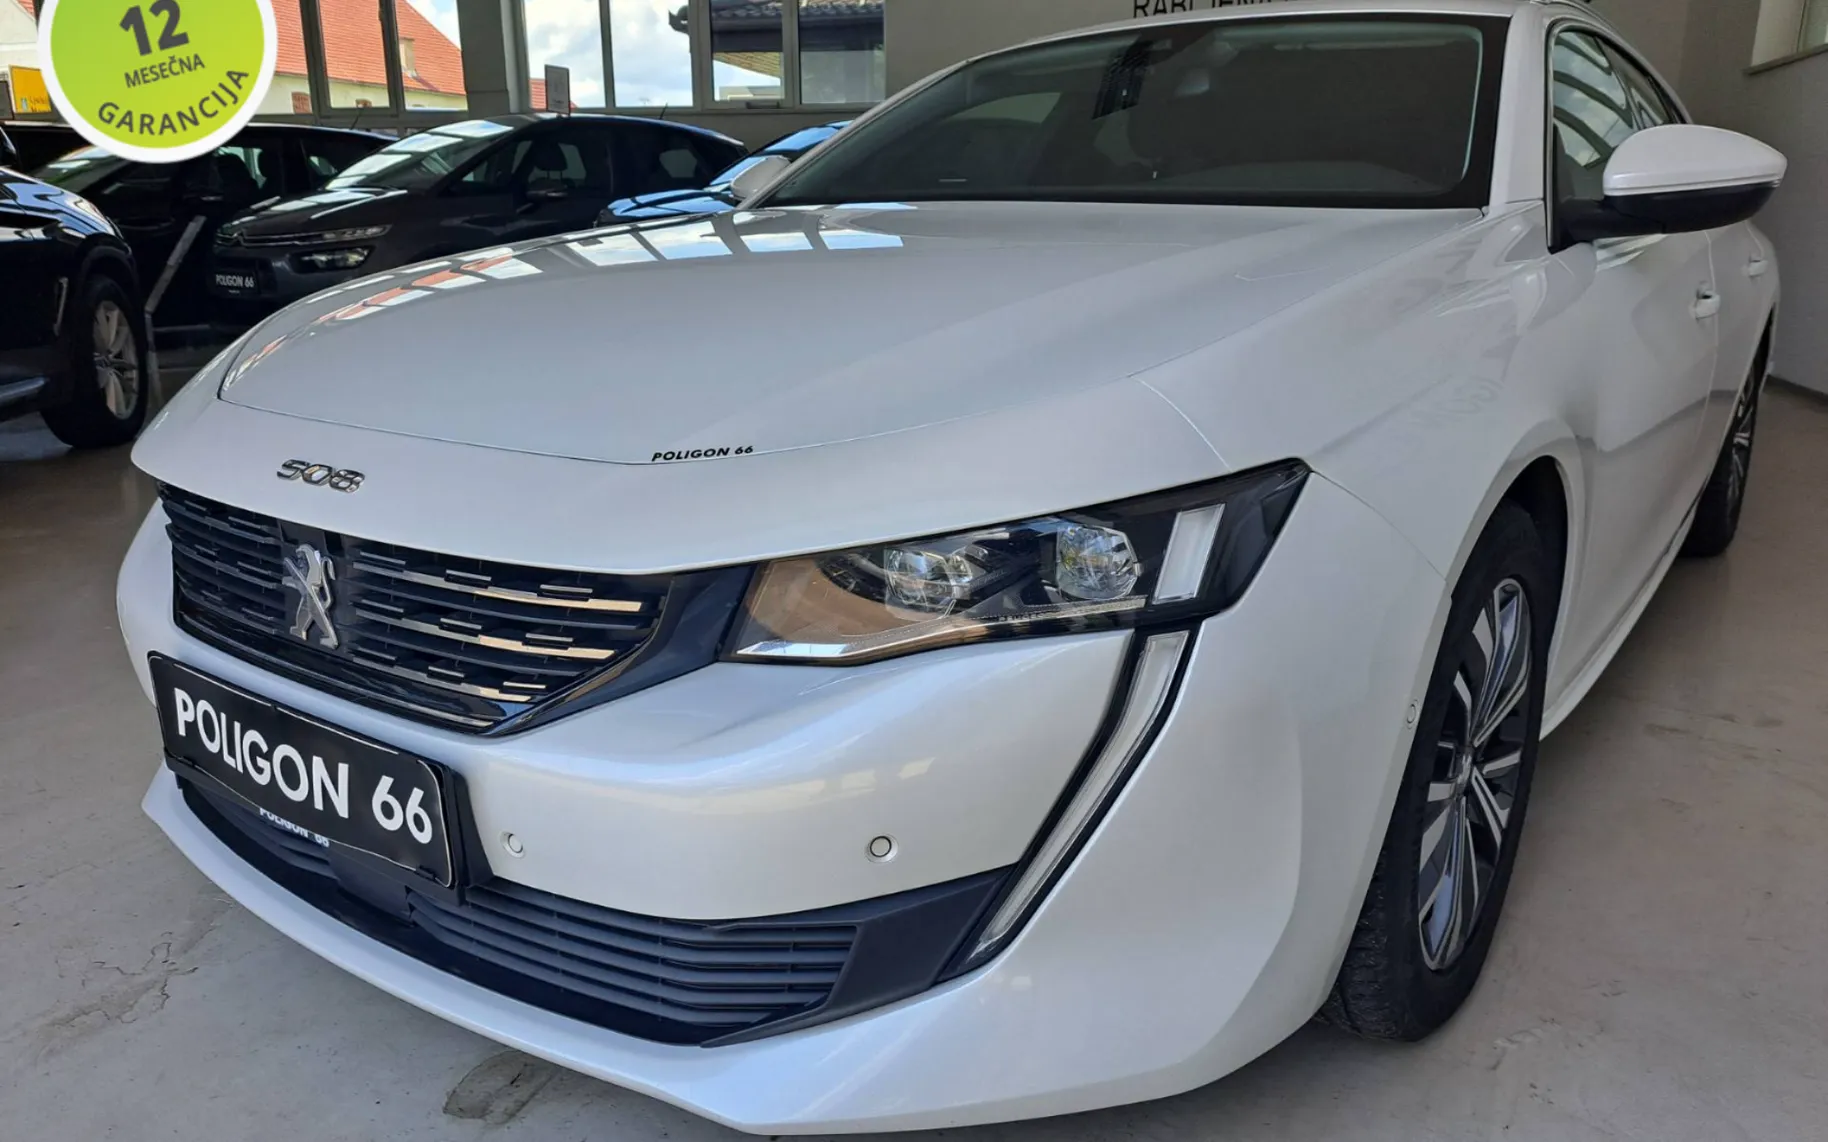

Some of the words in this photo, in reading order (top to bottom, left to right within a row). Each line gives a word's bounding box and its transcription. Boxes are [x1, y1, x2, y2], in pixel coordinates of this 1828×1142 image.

[651, 447, 730, 462] POLIGON
[734, 445, 754, 455] 66
[276, 459, 366, 493] 508
[174, 687, 349, 819] POLIGON
[371, 775, 433, 845] 66
